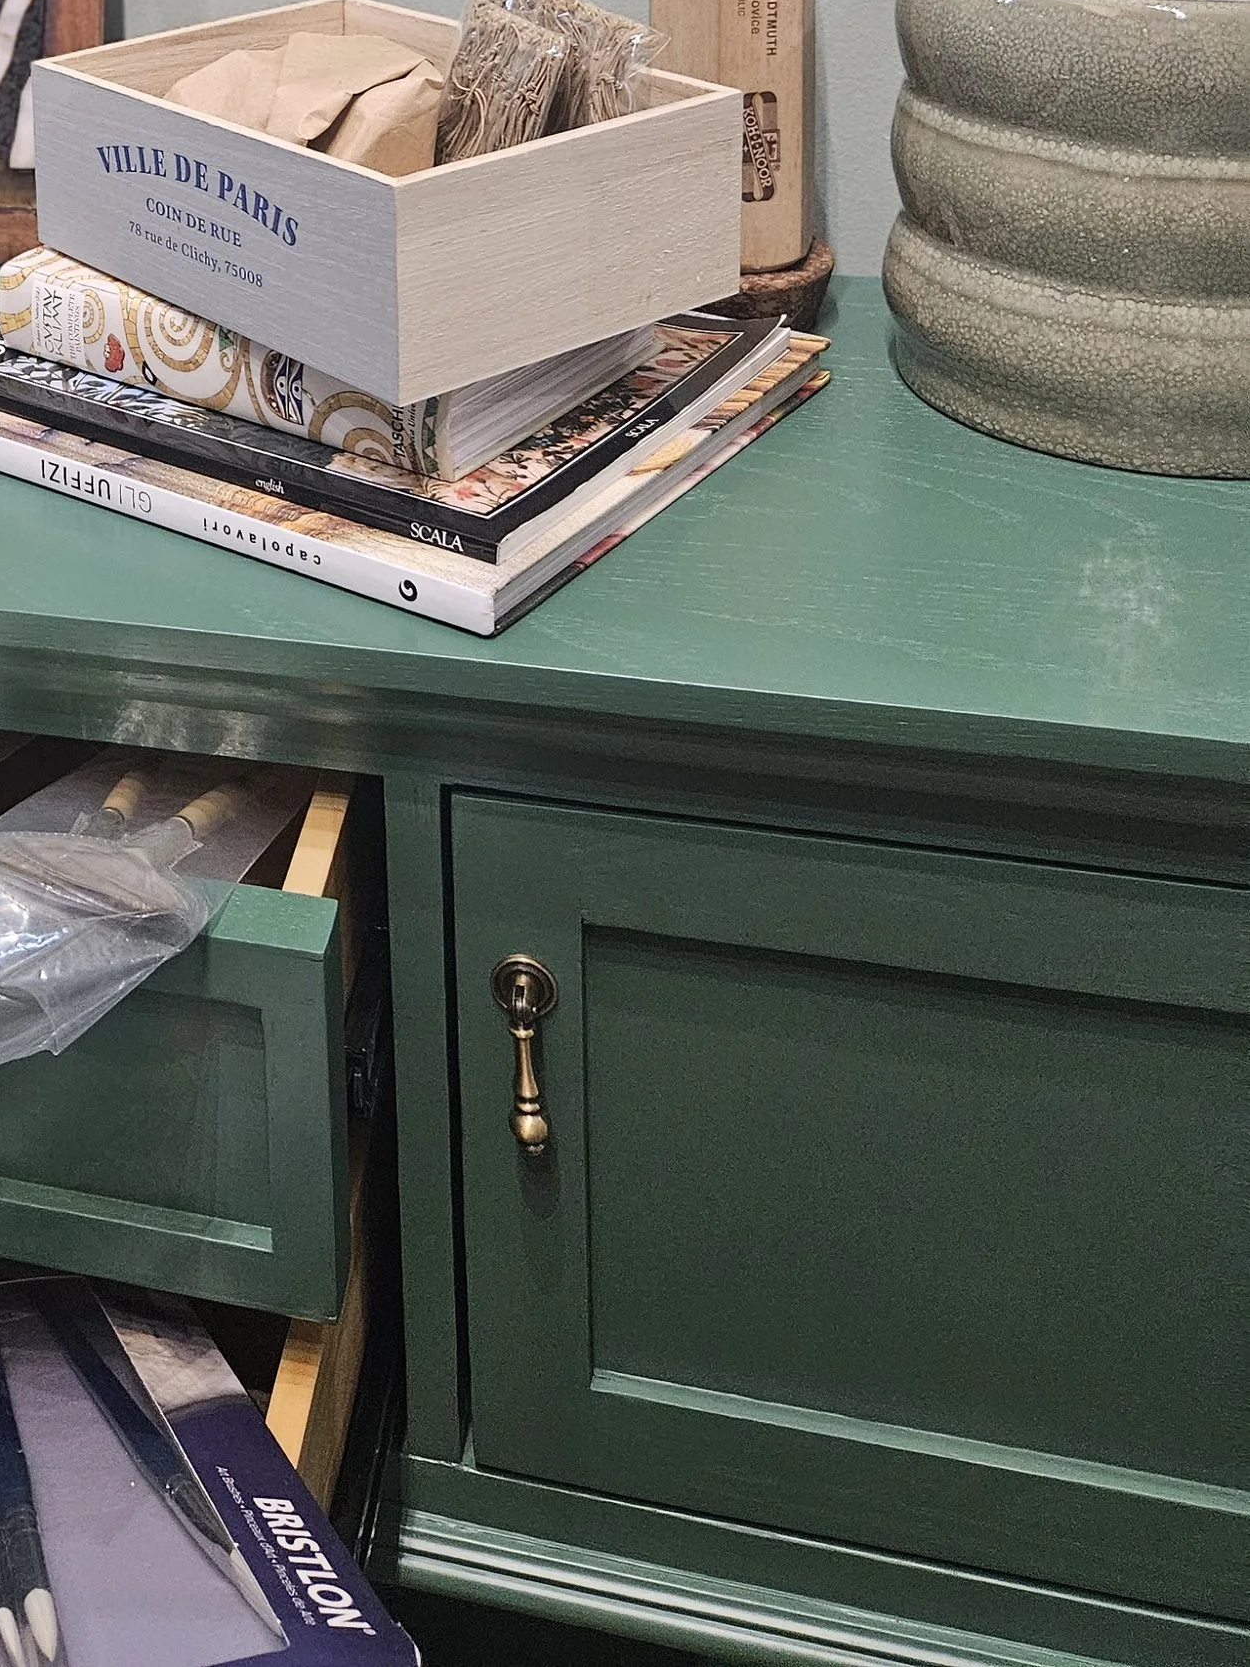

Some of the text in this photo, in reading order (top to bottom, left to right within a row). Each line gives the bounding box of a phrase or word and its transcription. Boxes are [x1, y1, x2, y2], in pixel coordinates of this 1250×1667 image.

[96, 145, 299, 246] VILLE DE PARIS
[146, 197, 242, 248] COIN DE RUE
[129, 221, 263, 288] 78 rue de Clichy, 75008
[53, 290, 64, 356] KLIMT
[391, 404, 406, 458] TASCH
[624, 418, 660, 438] SCALA
[40, 458, 153, 513] GLI UFFIZI
[255, 476, 285, 496] english
[202, 516, 322, 566] capolavori
[409, 522, 465, 553] SCALA
[253, 1497, 372, 1629] BRISTLON
